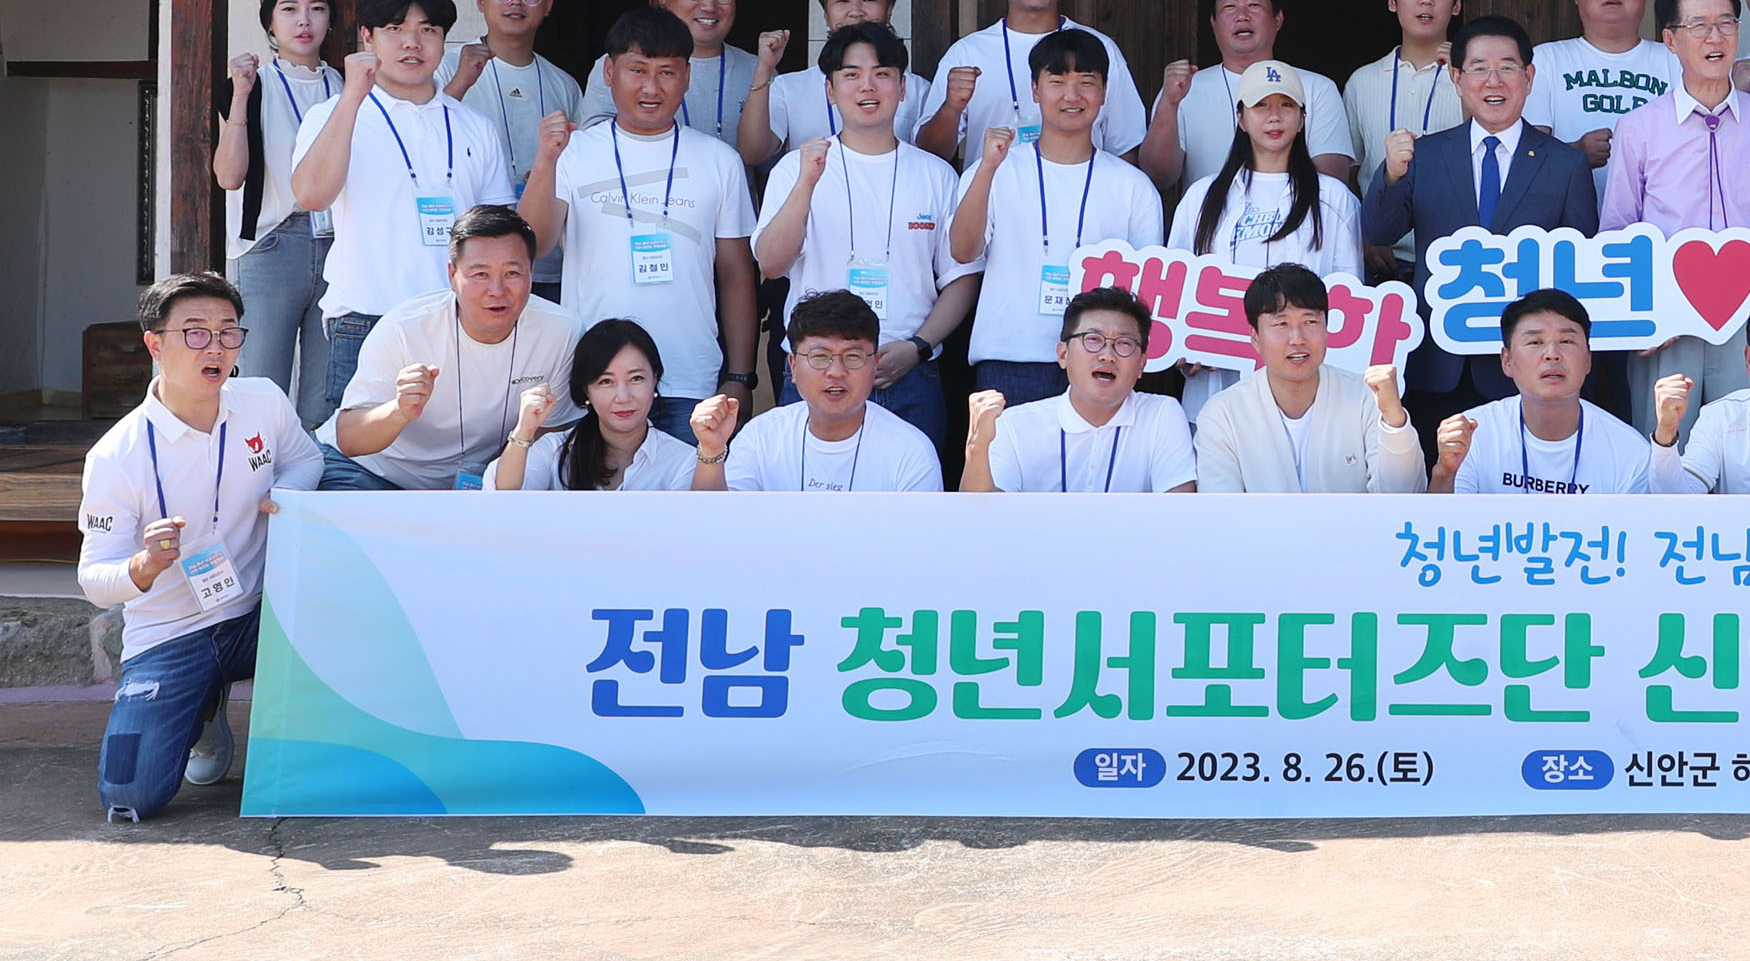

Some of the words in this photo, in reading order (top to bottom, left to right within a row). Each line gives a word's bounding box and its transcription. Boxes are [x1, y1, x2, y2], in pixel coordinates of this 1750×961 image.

[1563, 69, 1668, 96] MALBON
[630, 192, 659, 206] Klein
[1438, 235, 1657, 343] 청년
[248, 449, 272, 472] WAAC
[87, 514, 113, 532] WAAC
[1395, 521, 1627, 588] 청년발전!
[585, 608, 805, 719] 전남
[836, 607, 1606, 723] 청년서포터즈단
[1093, 752, 1147, 781] 일자
[1176, 752, 1270, 782] 2023.
[1282, 752, 1311, 783] 8.
[1324, 751, 1434, 786] 26.(토)
[1541, 754, 1595, 783] 장소
[1624, 751, 1720, 787] 신안군
